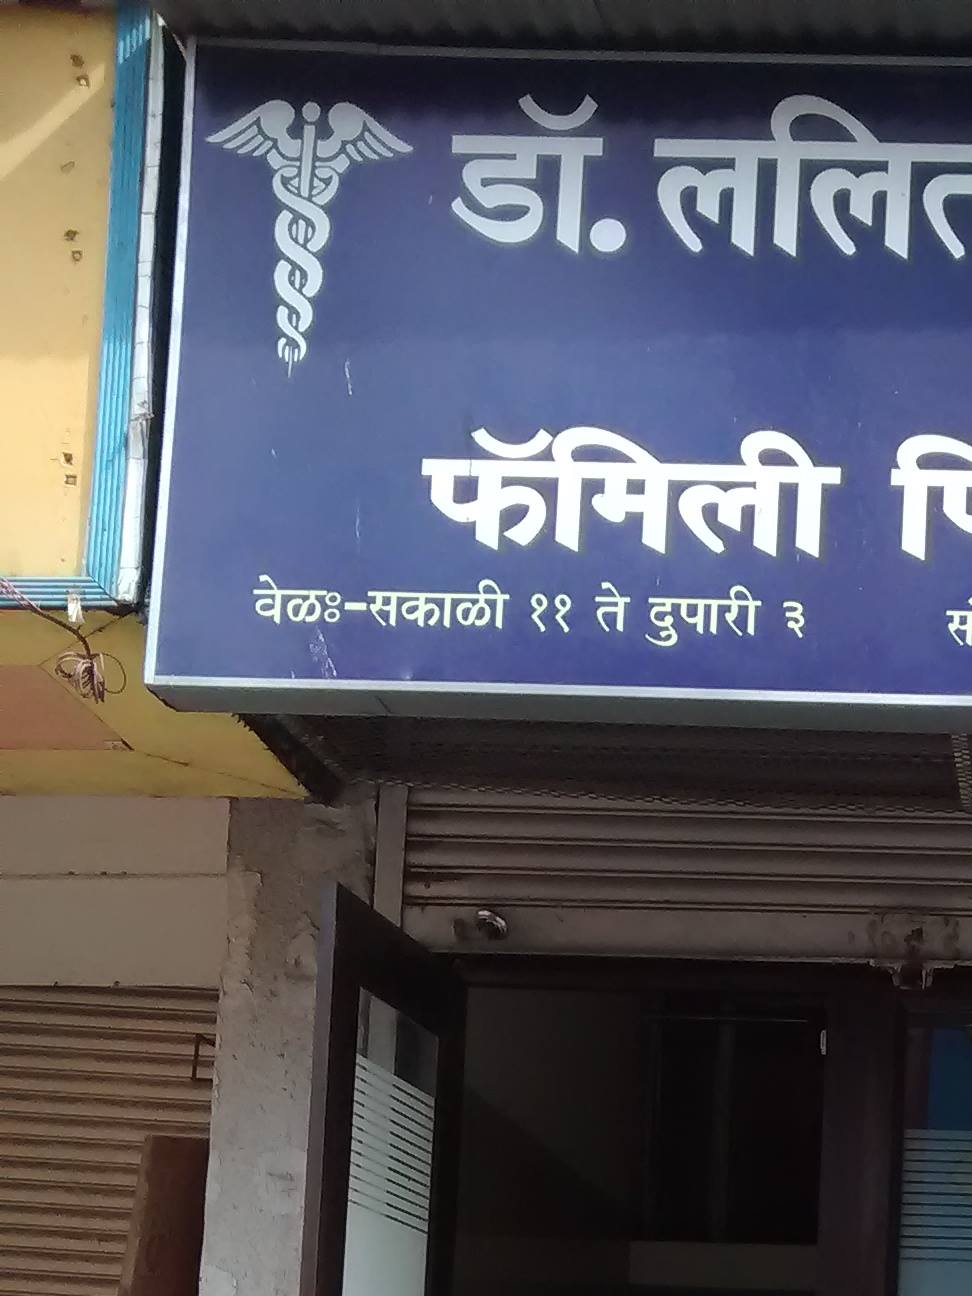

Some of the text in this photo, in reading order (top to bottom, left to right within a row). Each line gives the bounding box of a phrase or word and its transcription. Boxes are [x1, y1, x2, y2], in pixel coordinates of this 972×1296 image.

[531, 594, 571, 629] ११
[595, 582, 630, 631] ते
[646, 585, 761, 646] दुपारी
[783, 602, 804, 637] ३
